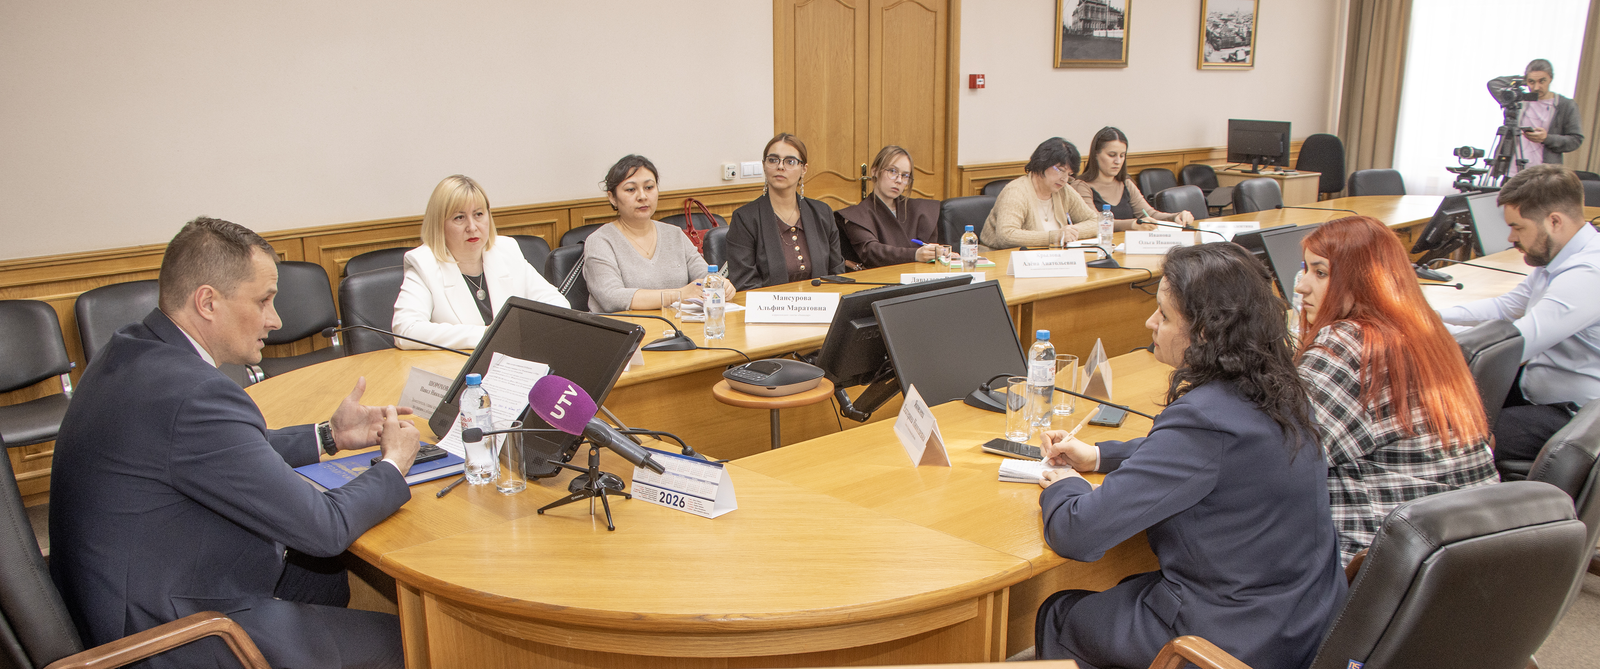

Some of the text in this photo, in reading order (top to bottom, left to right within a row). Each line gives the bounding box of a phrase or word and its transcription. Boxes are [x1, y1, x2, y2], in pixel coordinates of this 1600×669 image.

[773, 294, 812, 302] Мансурова
[757, 304, 827, 313] Альфия Маратовна
[549, 384, 578, 420] UTV
[659, 491, 685, 508] 2026
